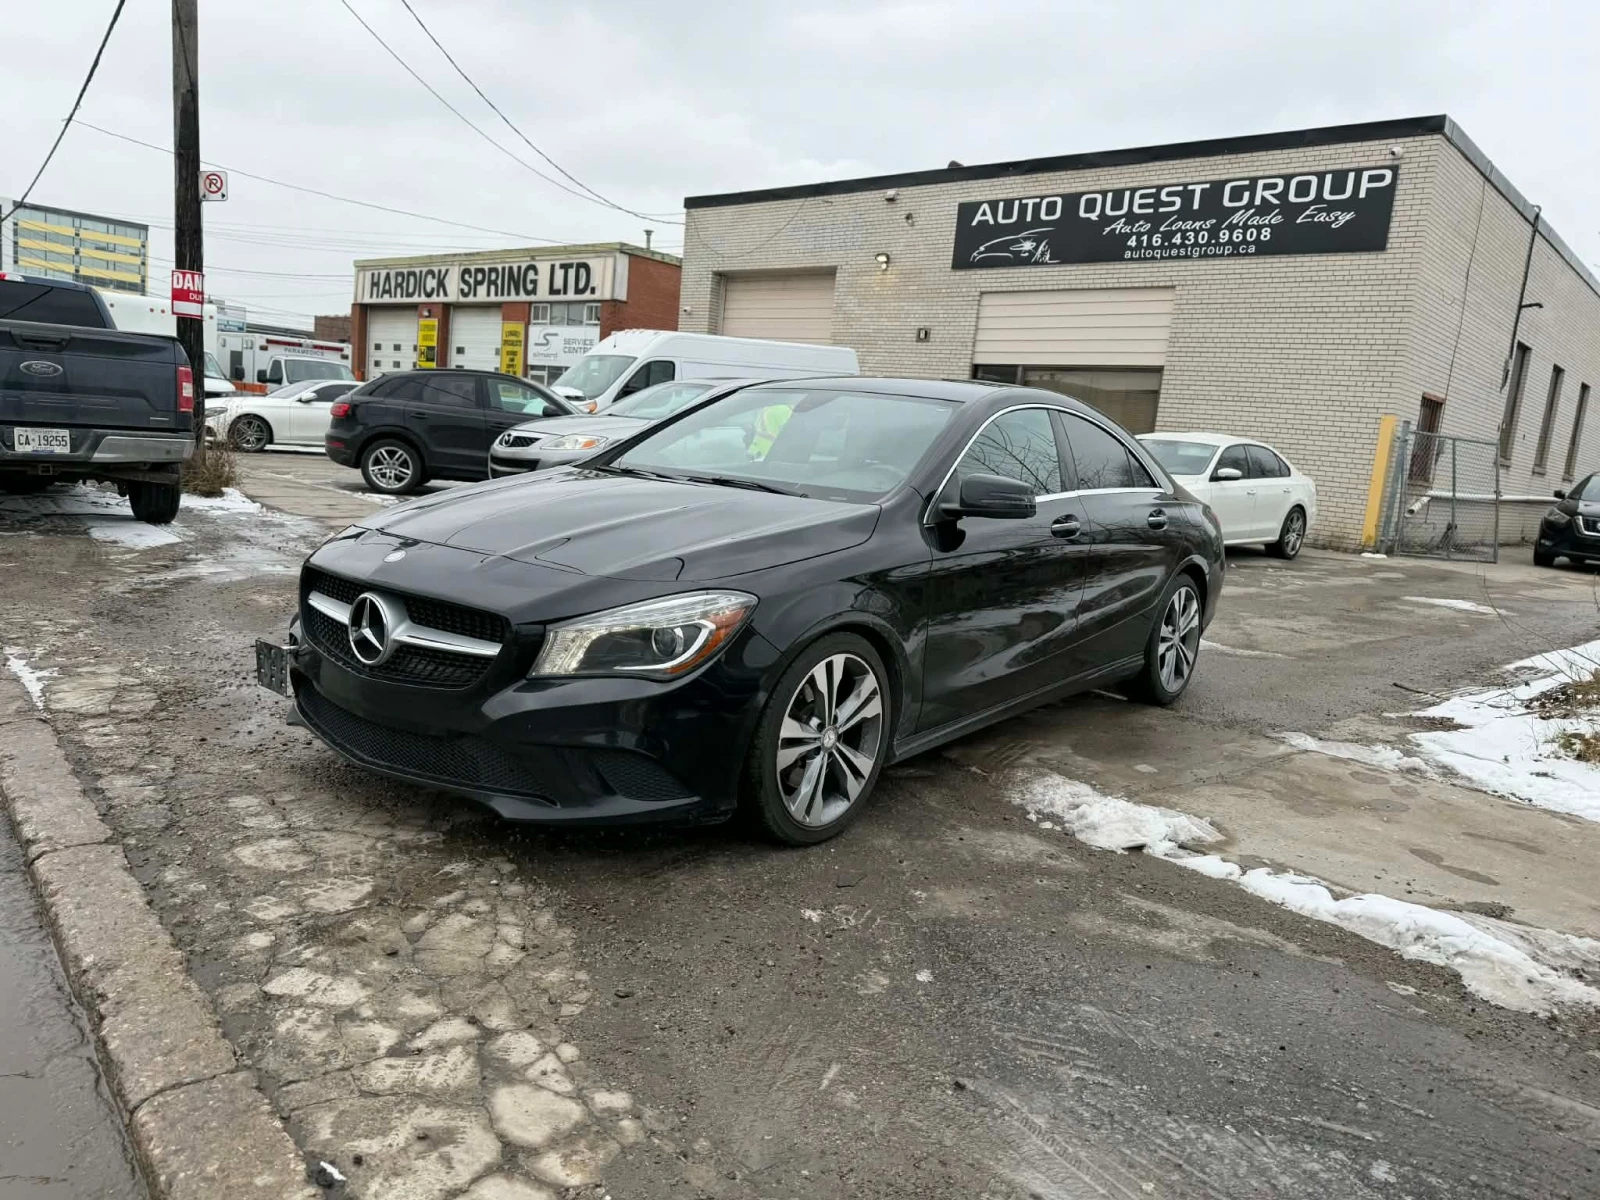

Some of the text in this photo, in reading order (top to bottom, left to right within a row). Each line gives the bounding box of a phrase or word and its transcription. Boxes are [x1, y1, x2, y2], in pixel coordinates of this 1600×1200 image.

[971, 168, 1393, 226] AUTO QUEST GROUP
[1102, 204, 1356, 235] Auto Loans Made Easy
[1126, 227, 1271, 248] 416.430.9608
[1124, 244, 1256, 259] autoquestgroup.ca
[369, 262, 596, 298] HARDICK SPRING LTD.
[563, 338, 594, 346] SERVICE
[284, 347, 325, 357] PARAMEDICS
[37, 435, 68, 447] 19255
